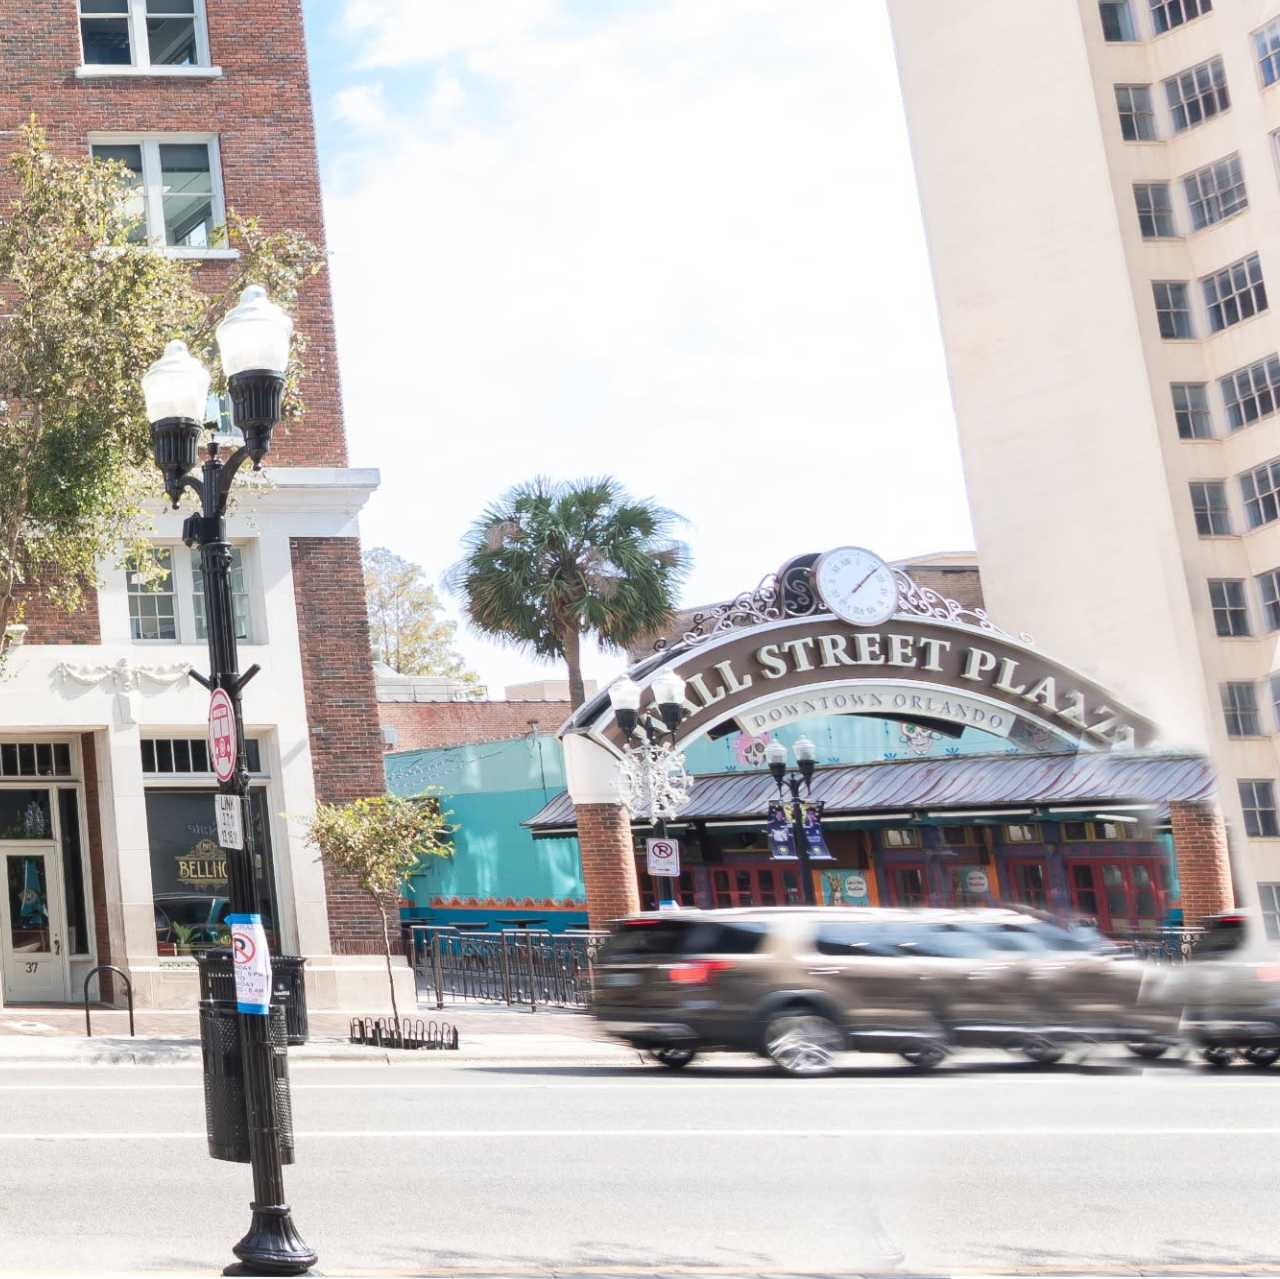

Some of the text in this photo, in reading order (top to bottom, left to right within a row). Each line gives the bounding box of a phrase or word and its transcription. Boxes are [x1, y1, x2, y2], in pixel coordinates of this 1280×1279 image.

[756, 633, 951, 679] STREET
[752, 692, 1004, 729] DOWNTOWN ORLANDO
[25, 962, 38, 974] 37
